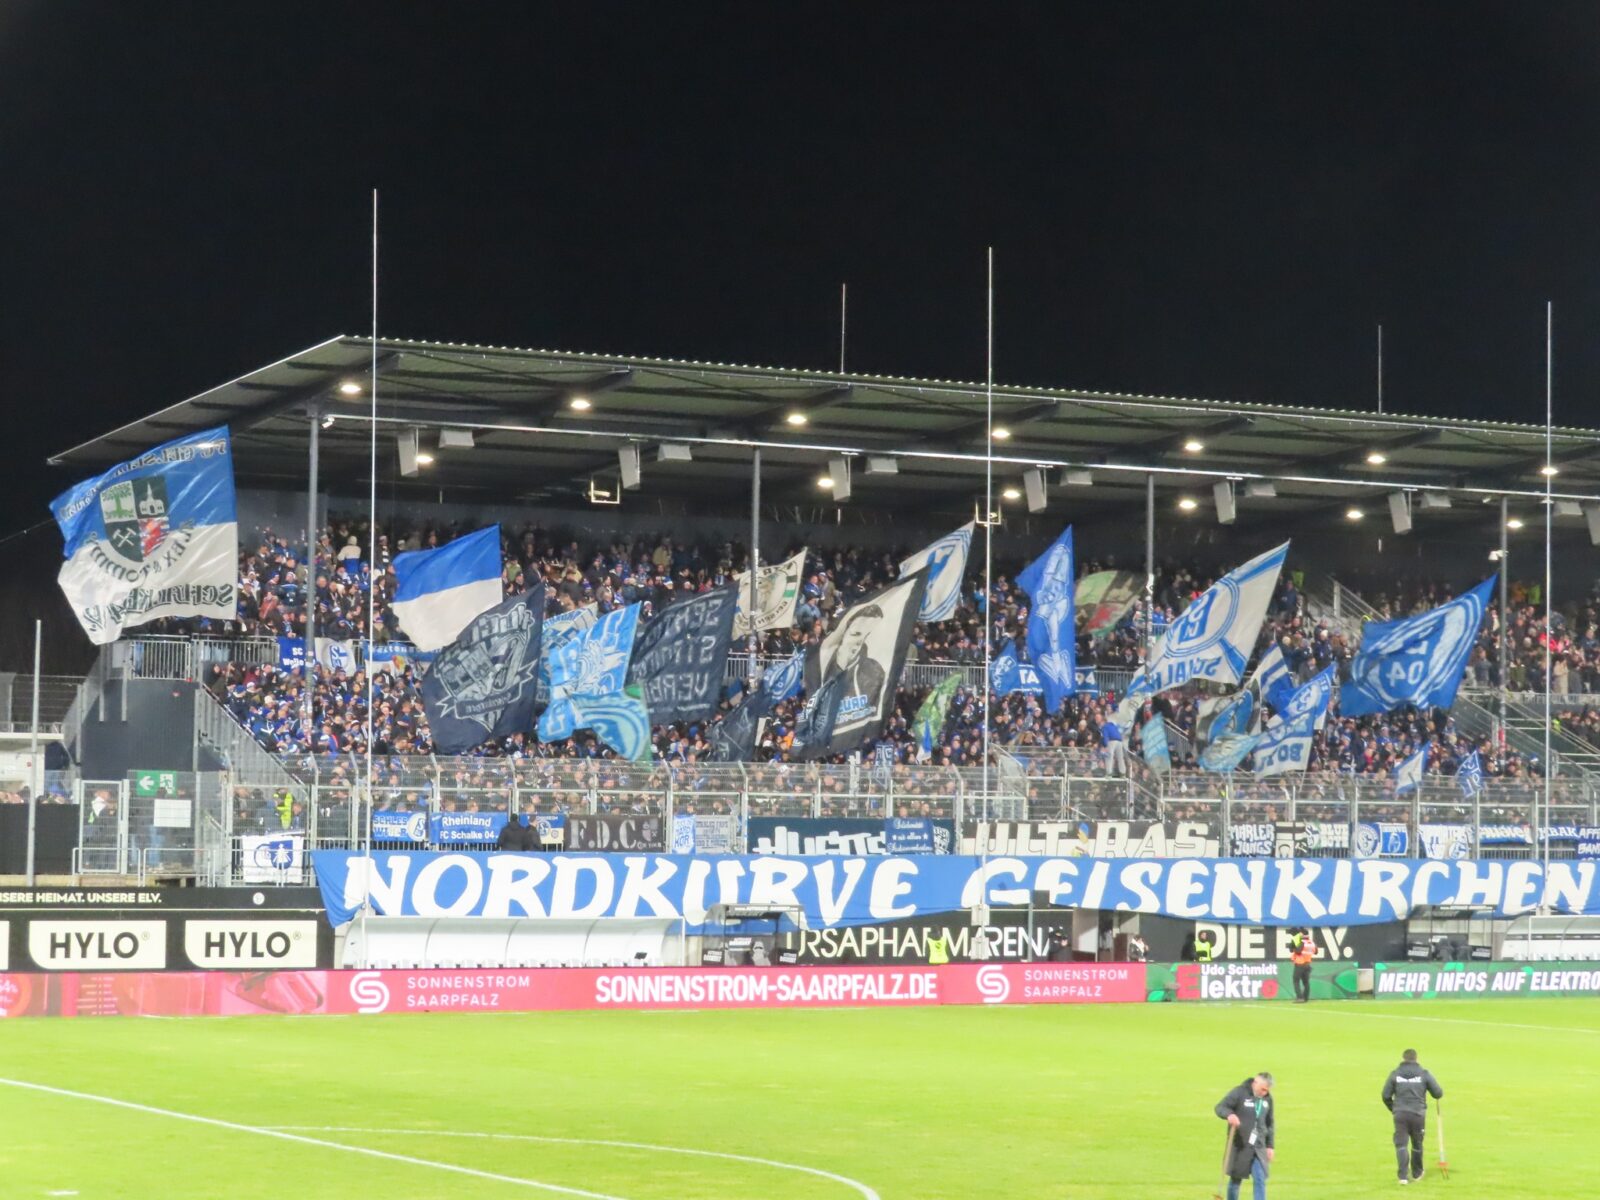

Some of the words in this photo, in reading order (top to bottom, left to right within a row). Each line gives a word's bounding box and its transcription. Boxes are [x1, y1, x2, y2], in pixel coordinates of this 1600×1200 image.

[442, 814, 492, 828] Rheinland
[451, 831, 482, 839] Schalke
[0, 892, 33, 904] SERE
[36, 892, 85, 904] HEIMAT.
[87, 892, 136, 904] UNSERE
[343, 854, 920, 929] NORDKURVE
[1024, 969, 1129, 981] SONNENSTROM
[1201, 963, 1226, 976] Udo
[1228, 963, 1278, 976] Schmidt
[407, 975, 530, 990] SONNENSTROM
[595, 973, 938, 1003] SONNENSTROM-SAARPFALZ.DE
[1378, 972, 1431, 993] MEHR
[1435, 972, 1488, 992] INFOS
[1491, 971, 1526, 992] AUF
[1024, 985, 1103, 998] SAARPFALZ
[407, 993, 499, 1008] SAARPFALZ
